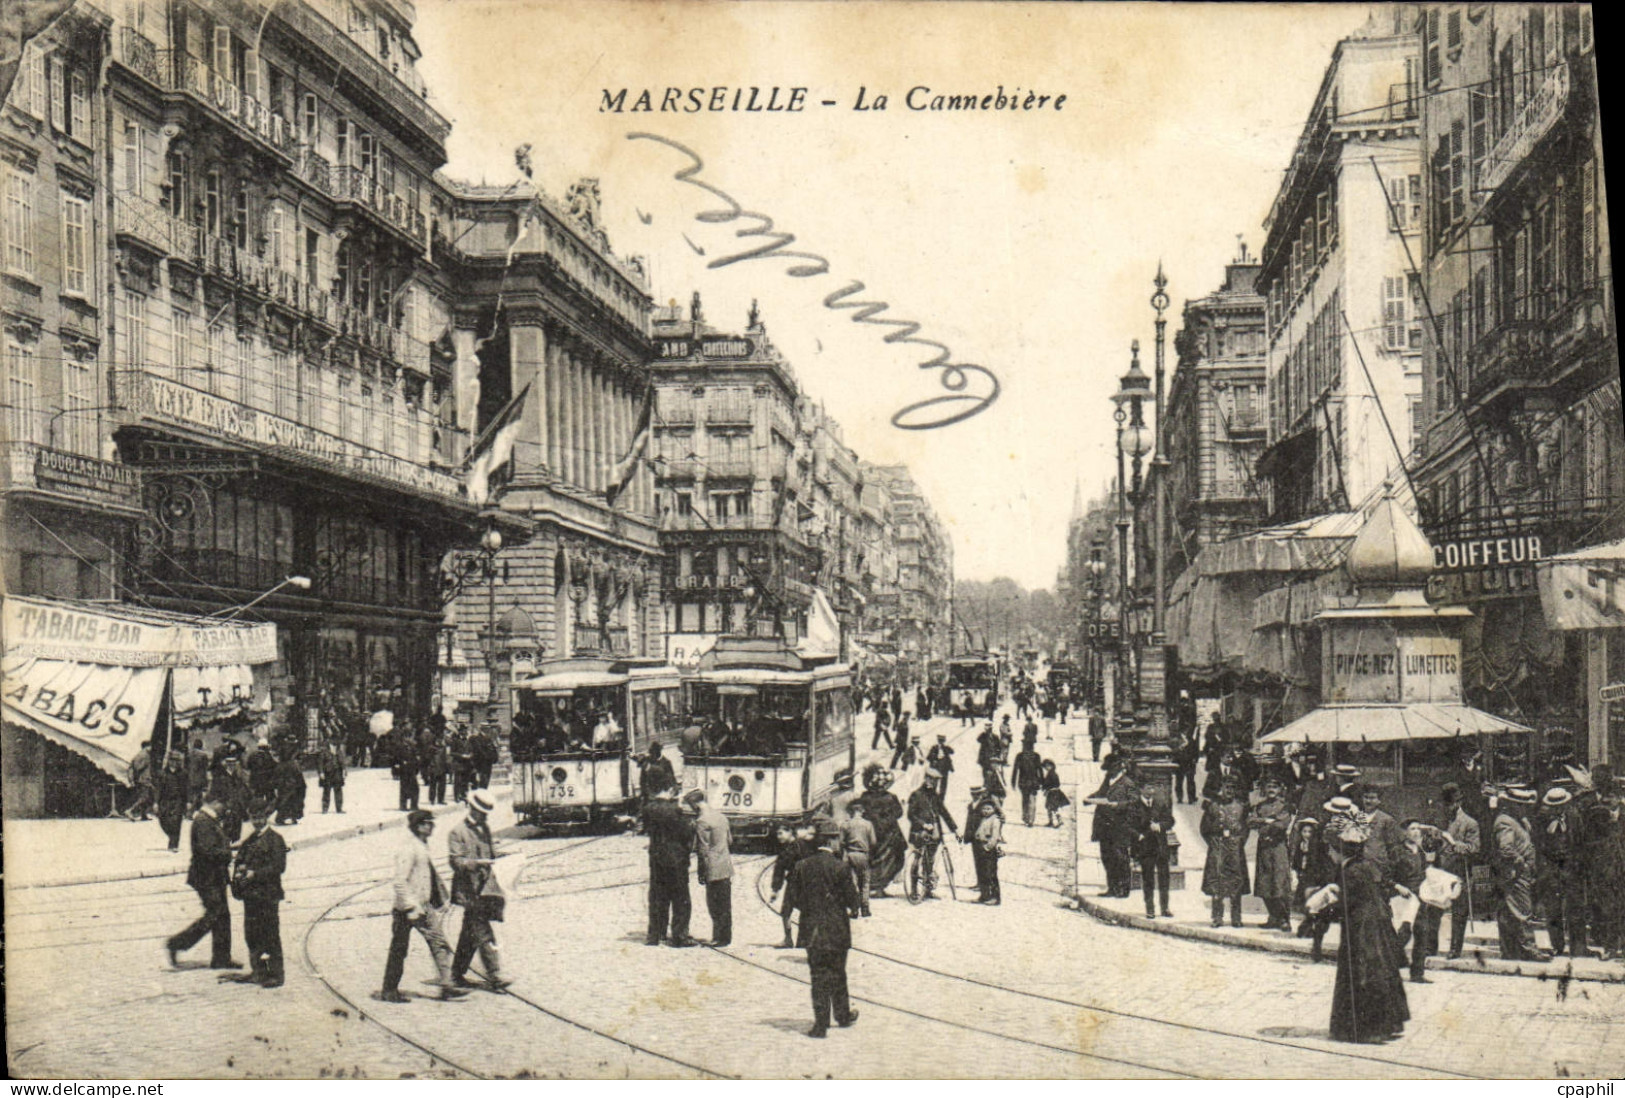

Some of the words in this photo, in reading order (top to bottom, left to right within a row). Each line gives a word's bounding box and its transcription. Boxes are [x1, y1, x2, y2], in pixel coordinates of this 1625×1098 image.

[41, 450, 93, 478] DOUGLAS
[99, 462, 132, 484] ADAIR
[1432, 535, 1542, 569] COIFFEUR
[1405, 653, 1458, 676] LUNETTES
[549, 785, 575, 798] 732
[722, 792, 753, 807] 708
